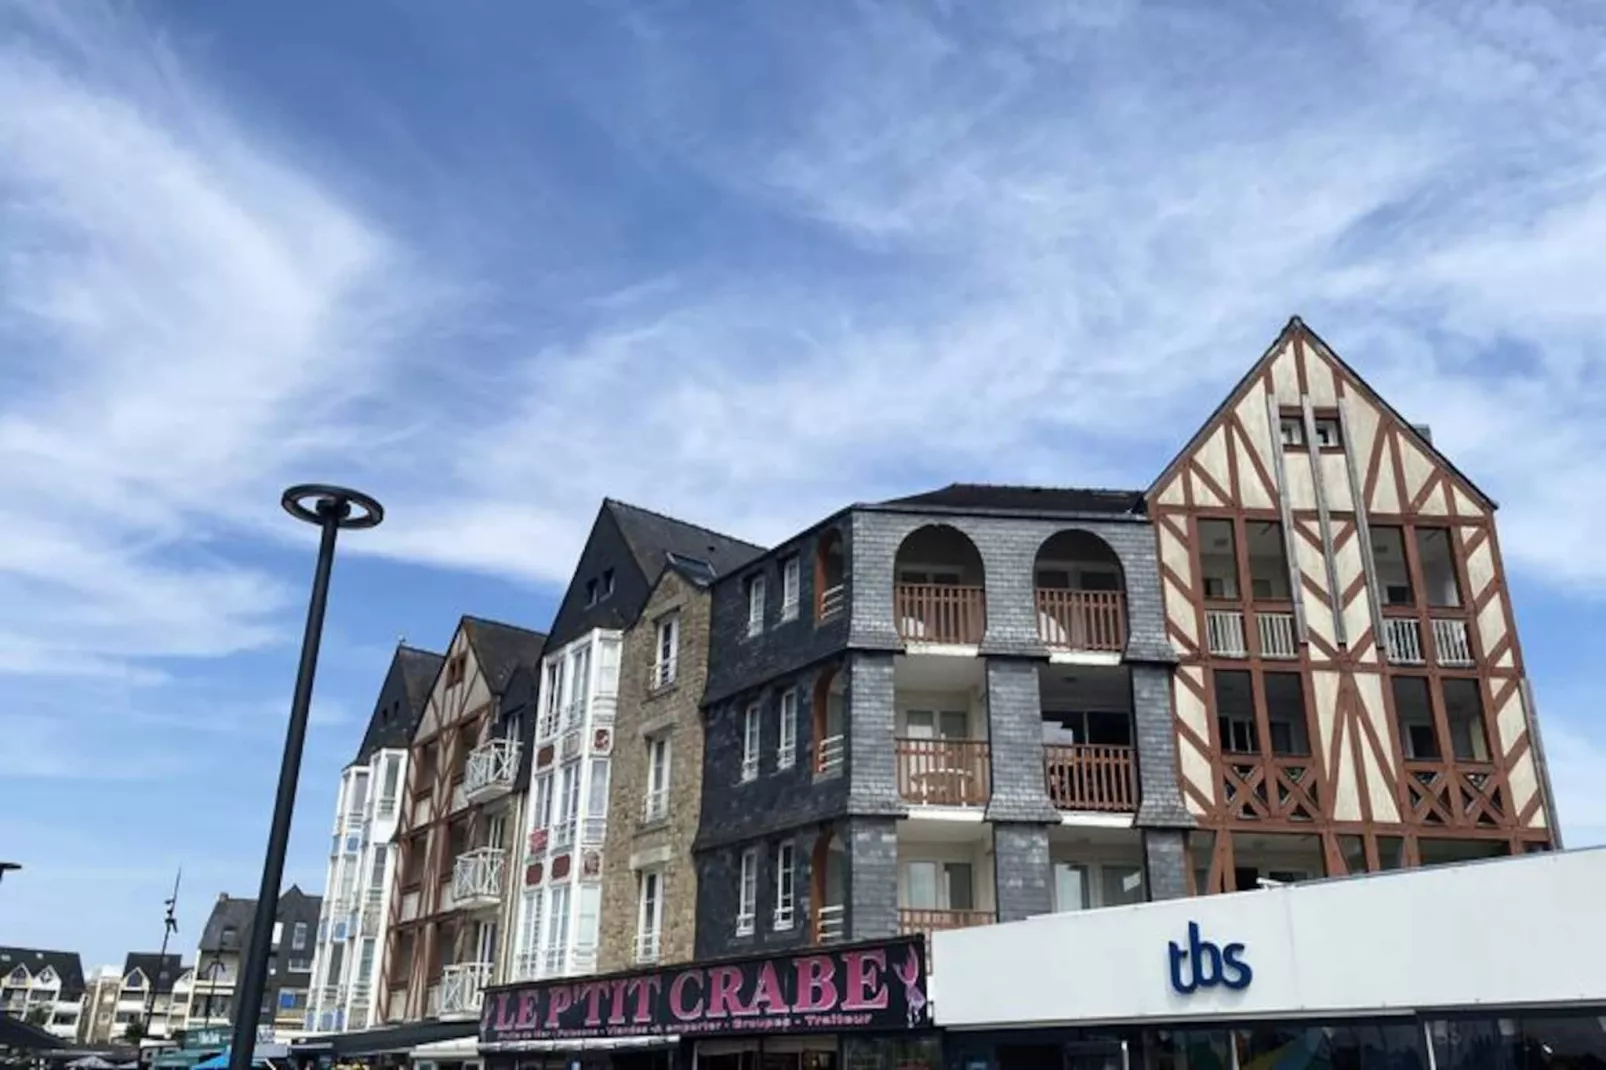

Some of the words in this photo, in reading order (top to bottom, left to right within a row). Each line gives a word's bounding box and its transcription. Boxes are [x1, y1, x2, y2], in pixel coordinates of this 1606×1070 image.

[494, 990, 538, 1030] LE
[545, 974, 662, 1028] P'TIT
[669, 948, 889, 1020] CRABE
[1168, 920, 1252, 994] tbs
[804, 1013, 873, 1026] Traiteur
